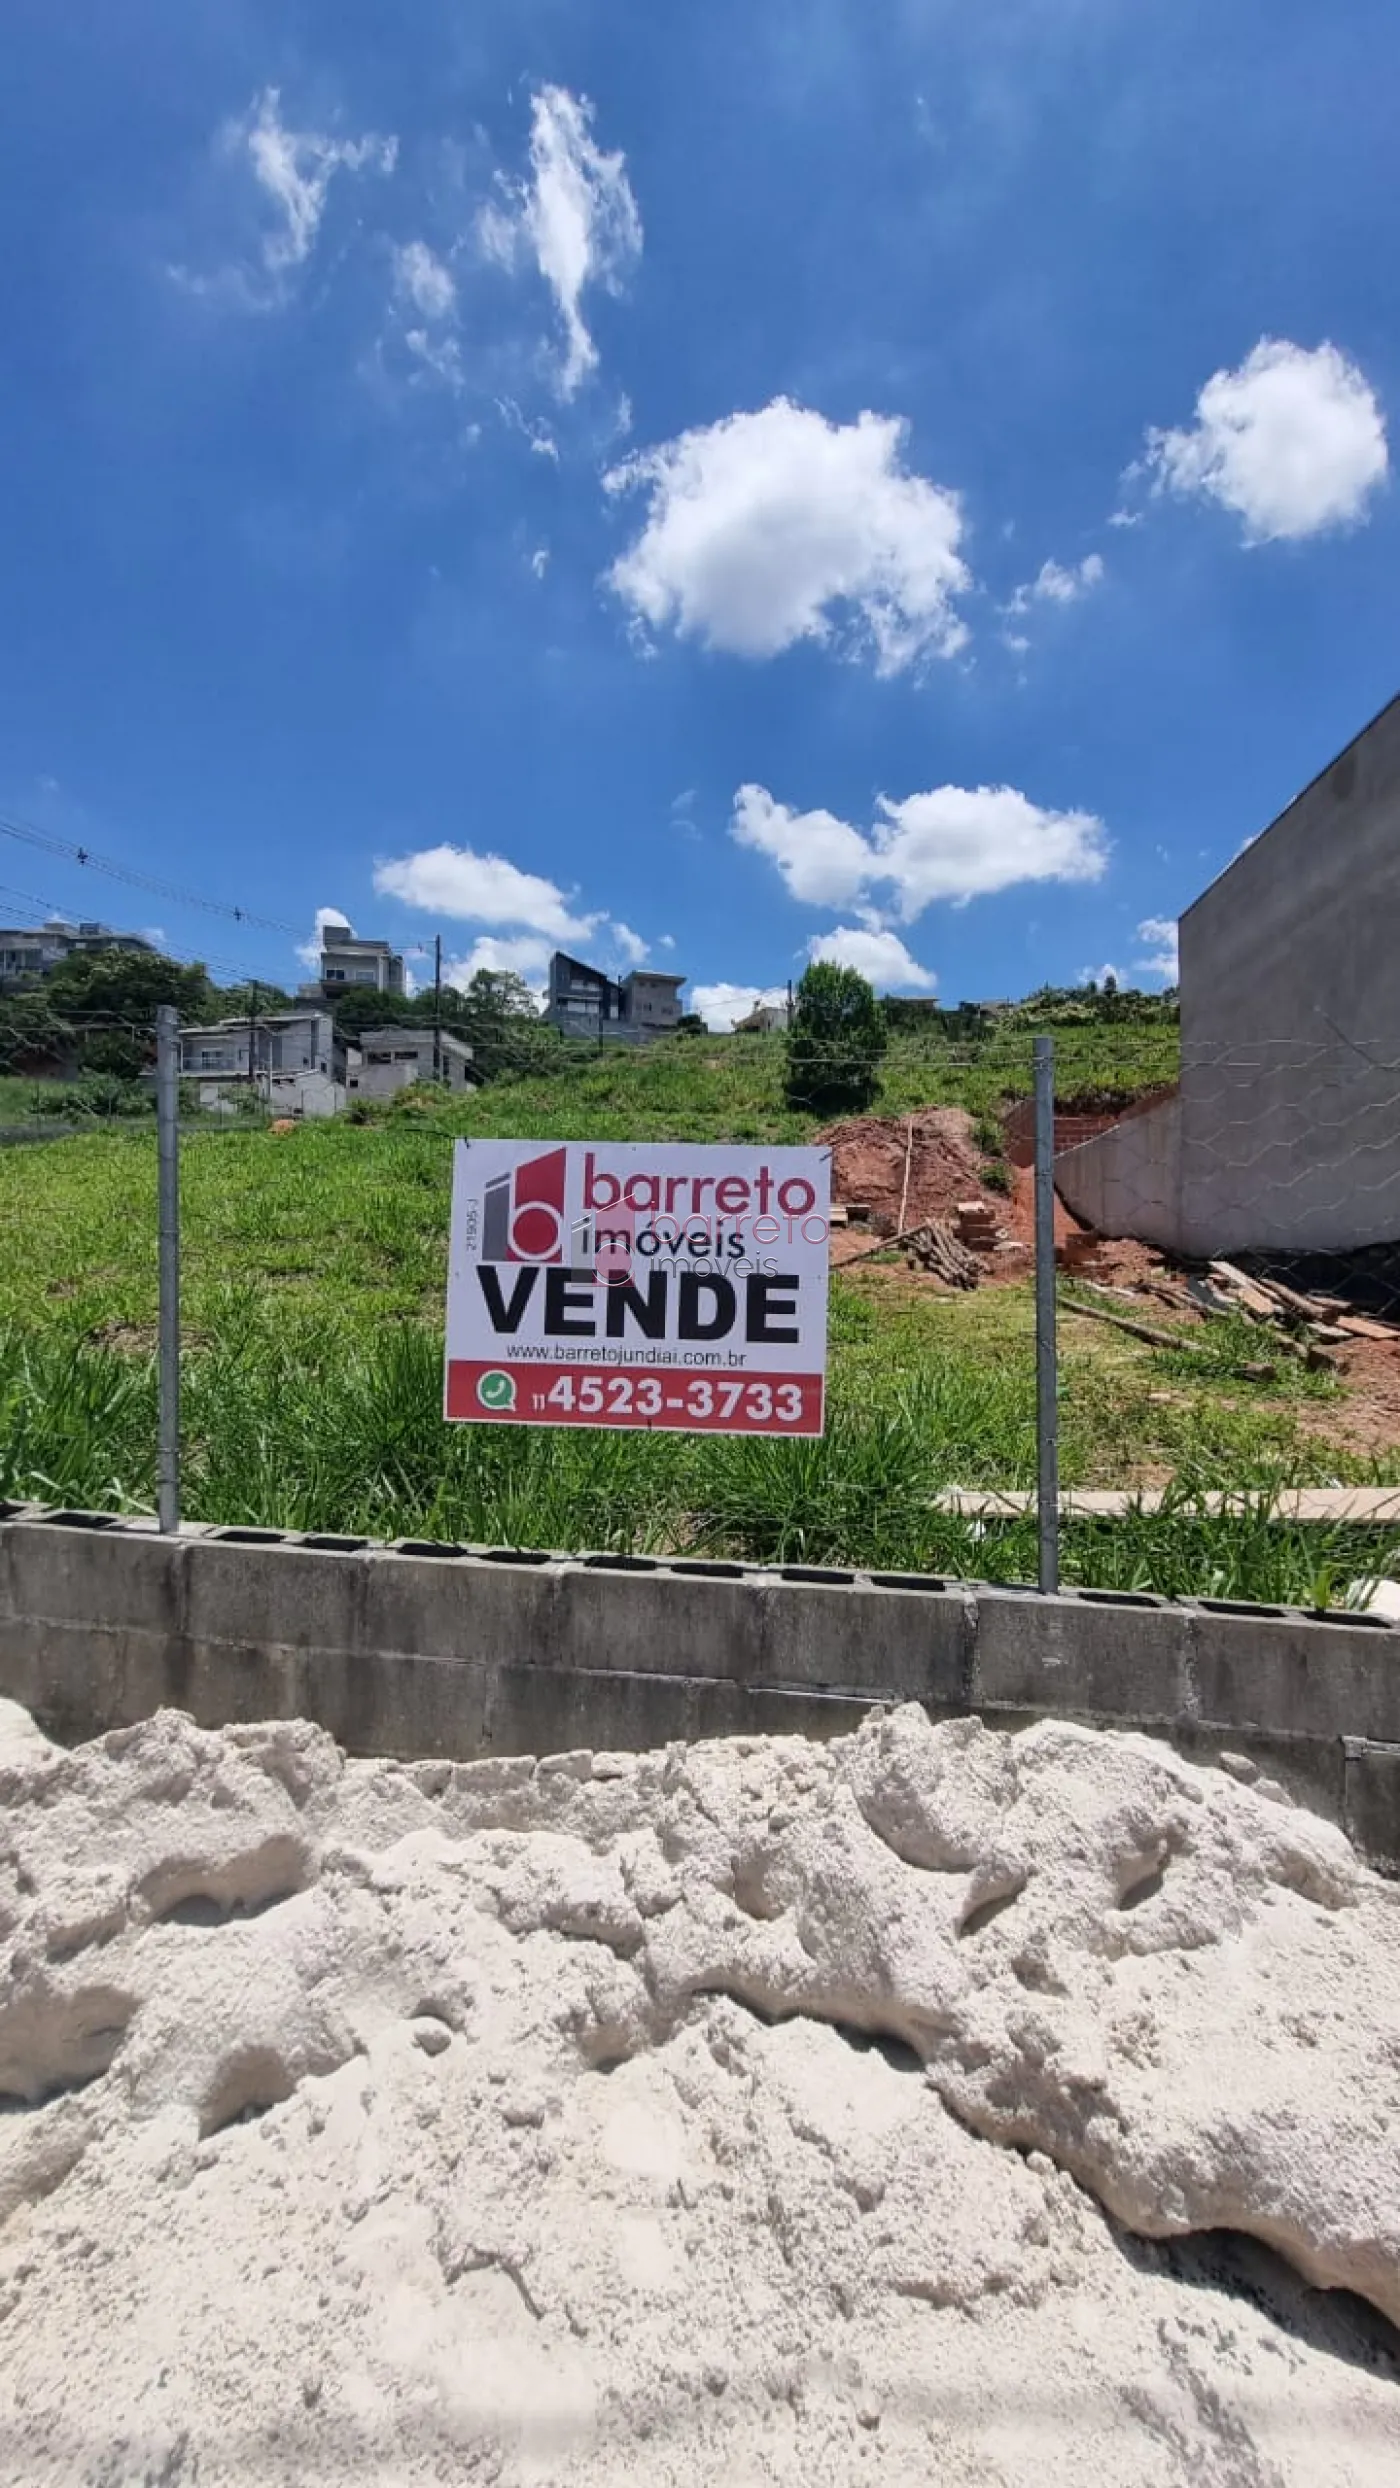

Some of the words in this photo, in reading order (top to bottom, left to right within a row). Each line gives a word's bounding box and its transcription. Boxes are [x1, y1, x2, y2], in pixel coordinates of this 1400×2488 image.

[582, 1152, 815, 1215] barreto
[582, 1217, 746, 1258] imóveis
[477, 1265, 800, 1344] VENDE
[506, 1343, 747, 1367] www.barretojundiai.com.br
[548, 1375, 803, 1422] 4523-3733
